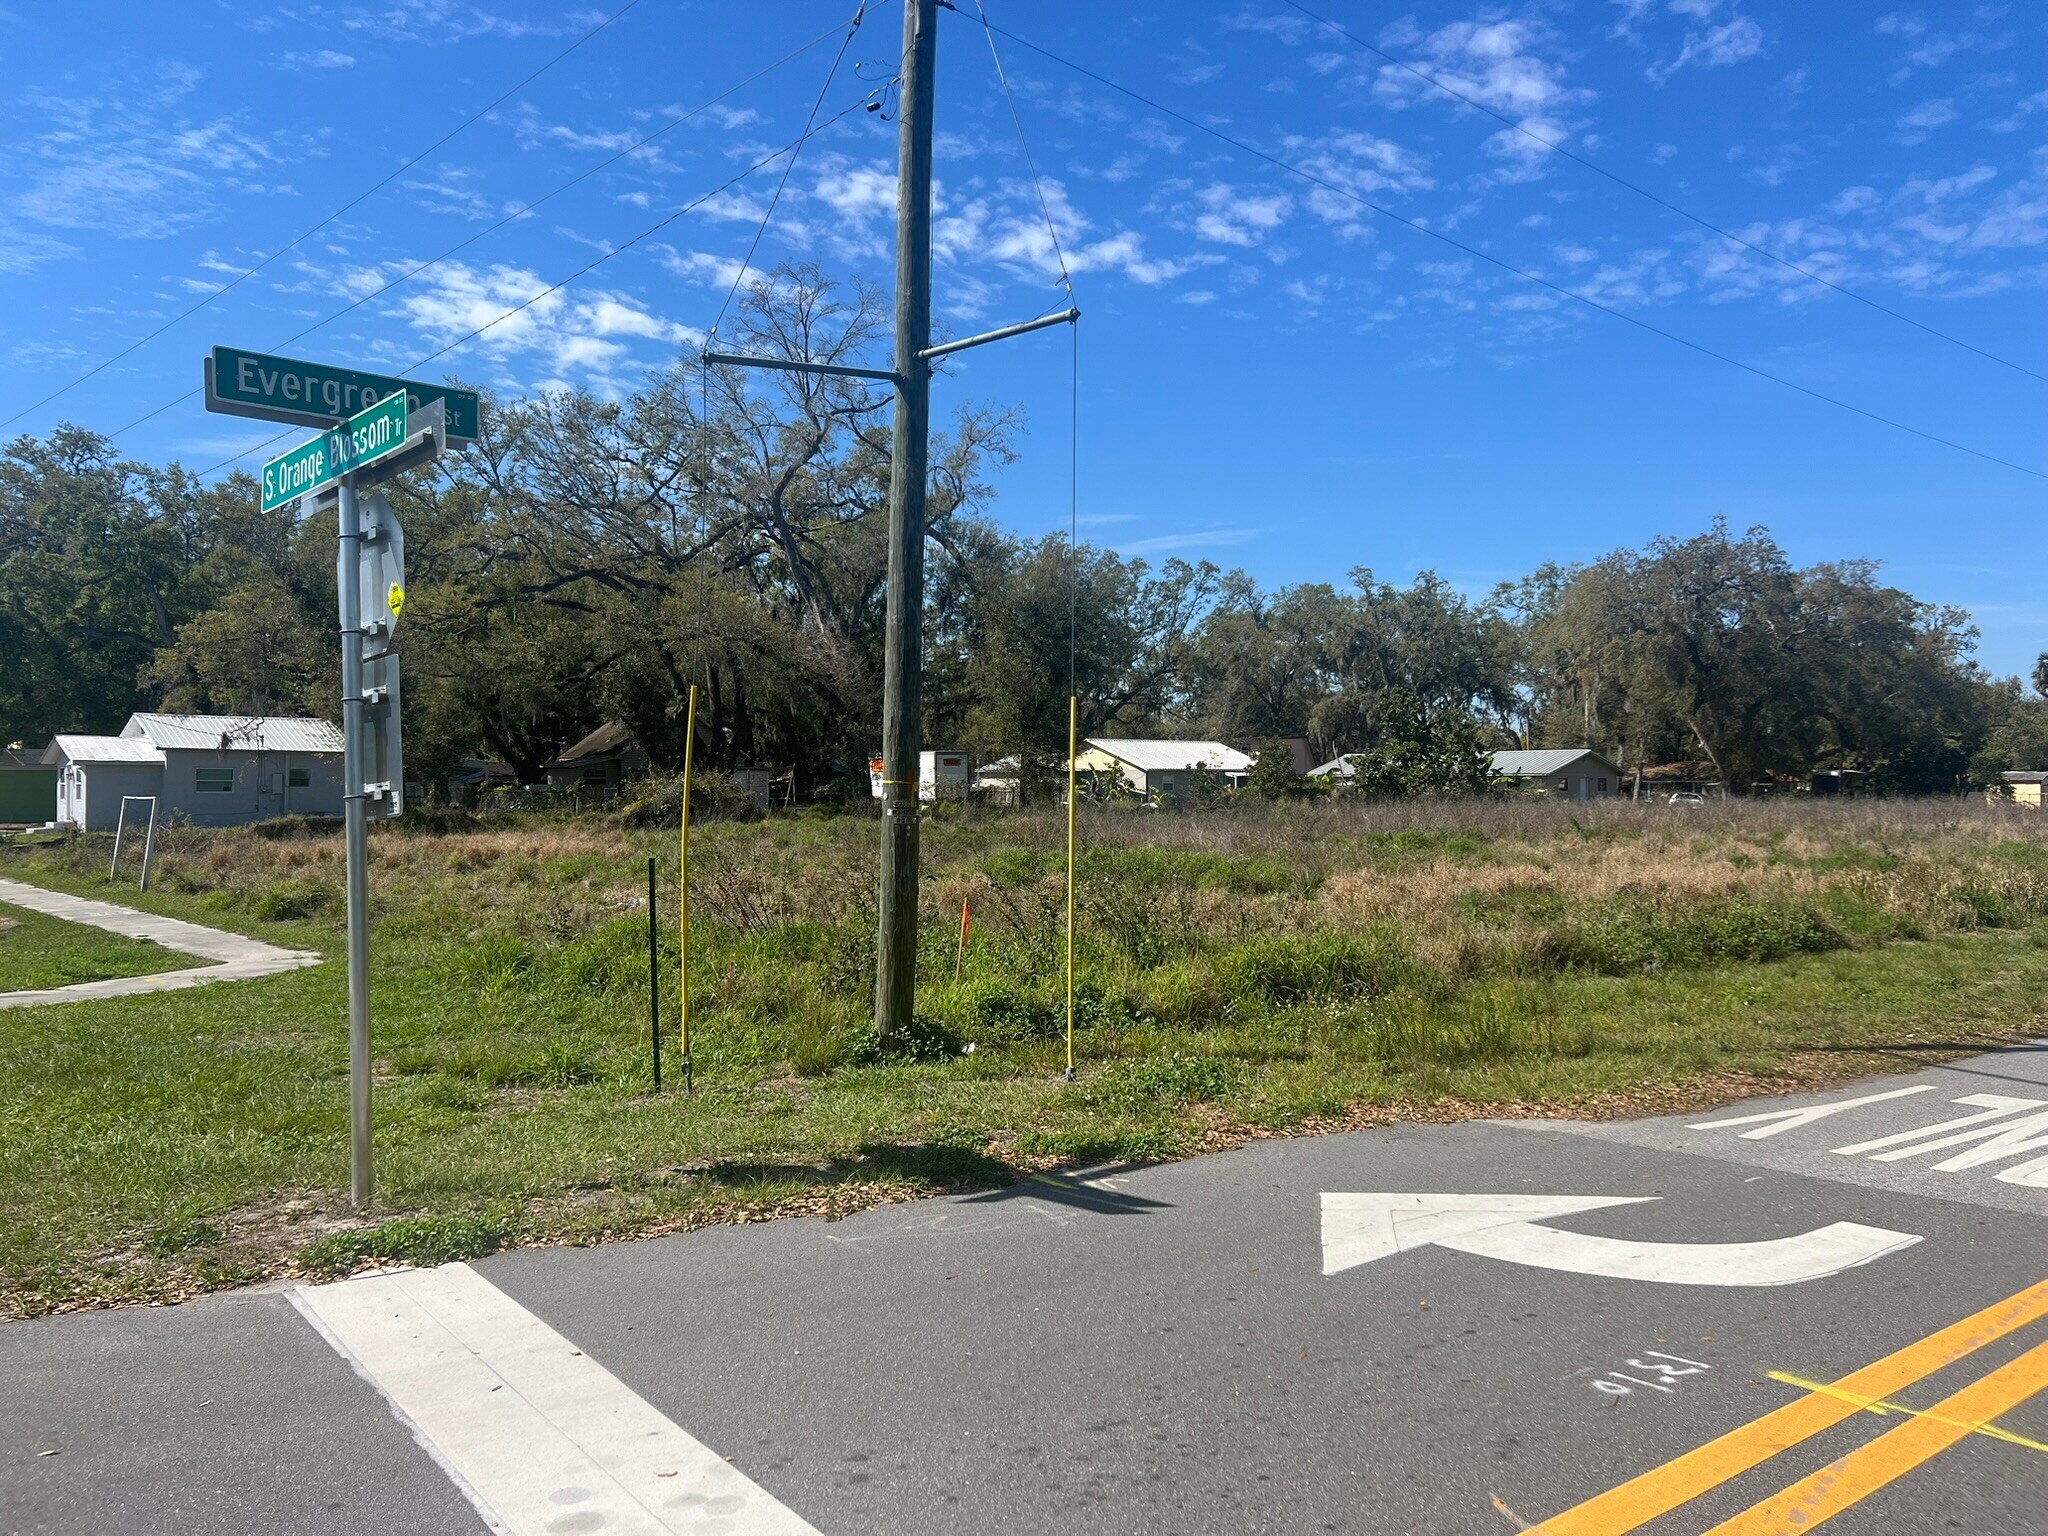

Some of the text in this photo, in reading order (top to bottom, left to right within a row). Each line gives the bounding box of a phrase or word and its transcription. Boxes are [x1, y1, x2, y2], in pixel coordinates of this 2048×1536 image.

[445, 408, 462, 427] St
[279, 449, 324, 495] Orange
[330, 415, 390, 469] Blossom
[394, 417, 402, 437] Tr
